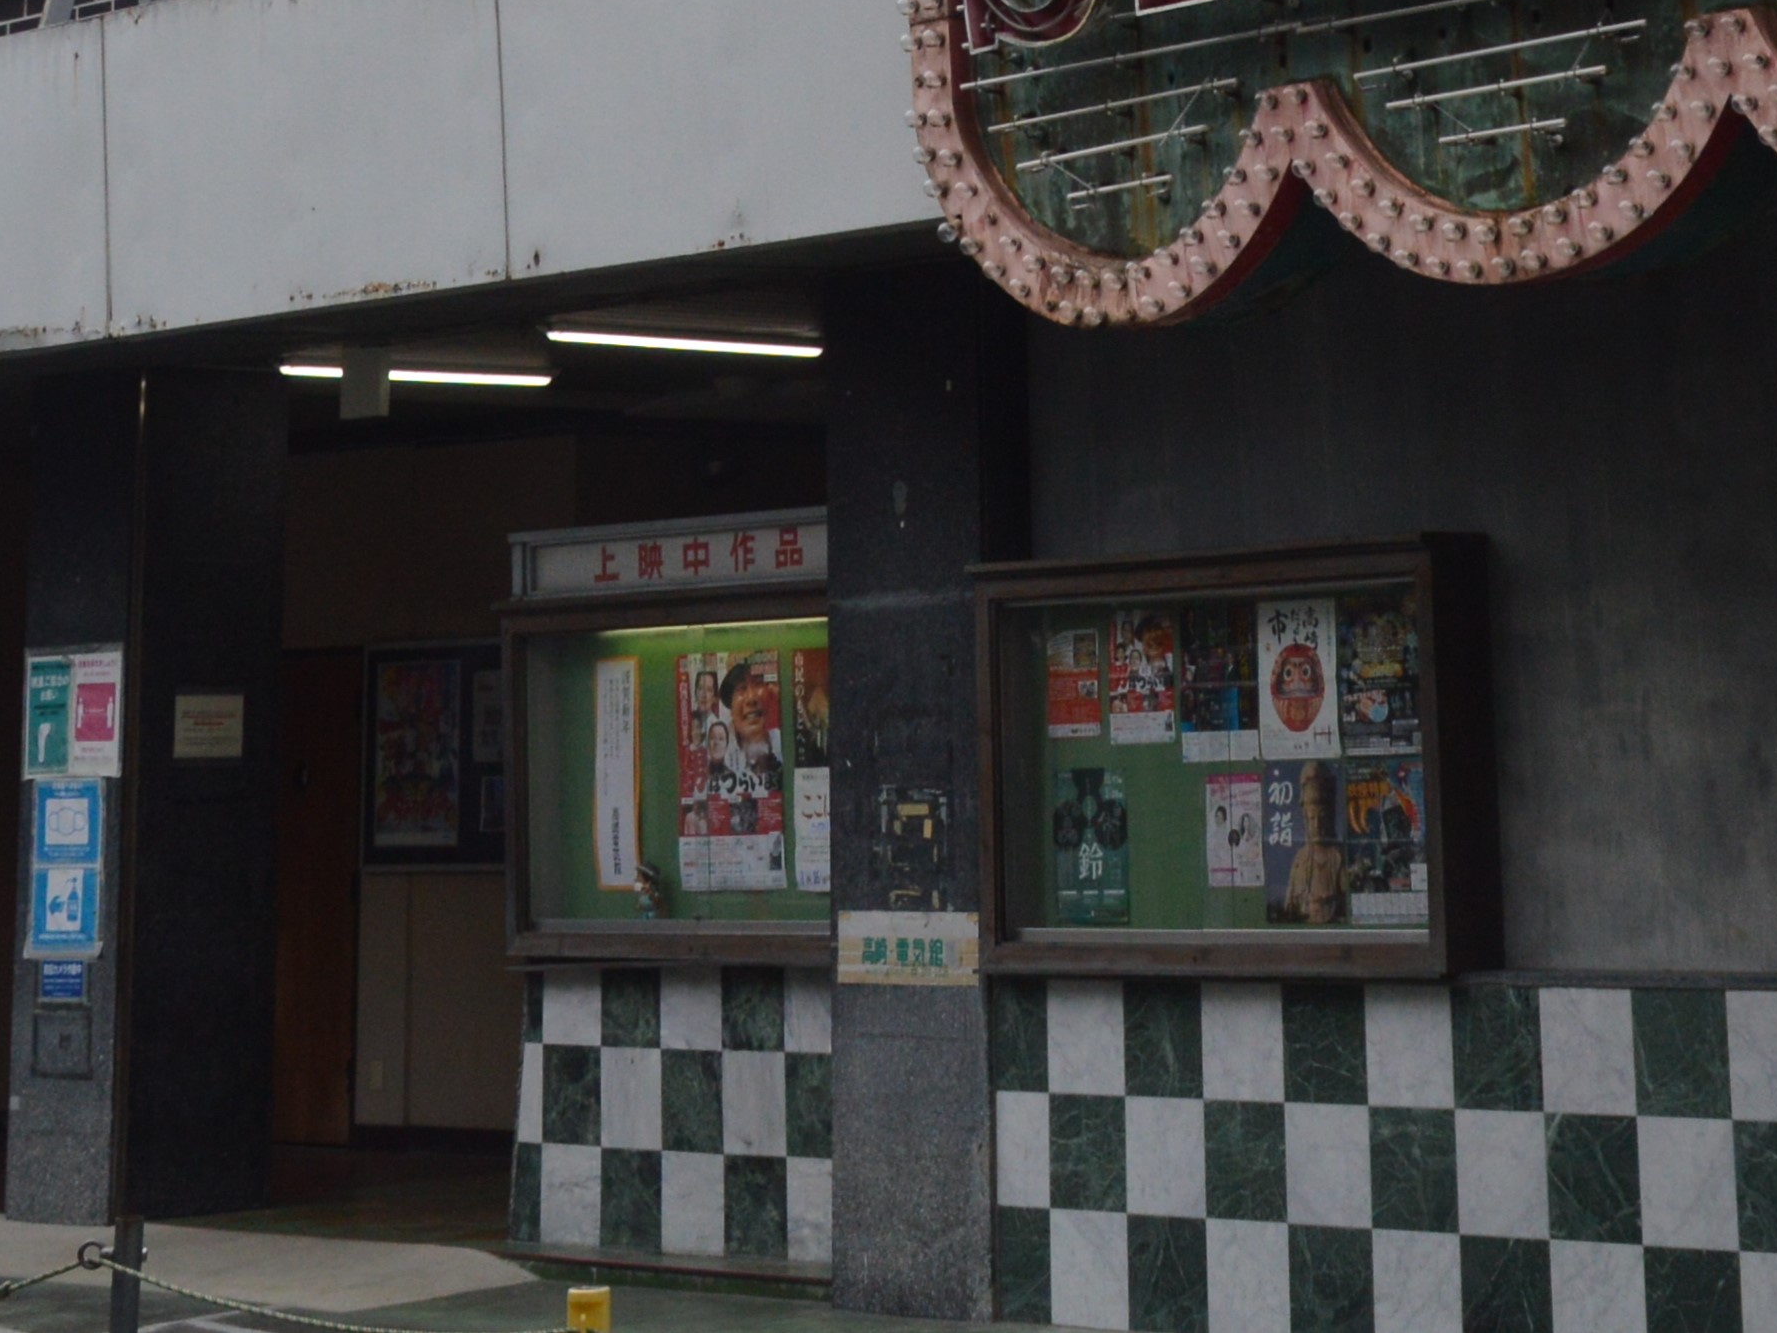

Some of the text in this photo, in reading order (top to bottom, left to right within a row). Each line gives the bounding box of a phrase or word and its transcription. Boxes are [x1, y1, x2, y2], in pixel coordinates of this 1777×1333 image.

[594, 526, 804, 583] 上映中作品
[1267, 609, 1289, 645] 市
[1267, 780, 1295, 848] 初詣
[1078, 841, 1104, 881] 鈴
